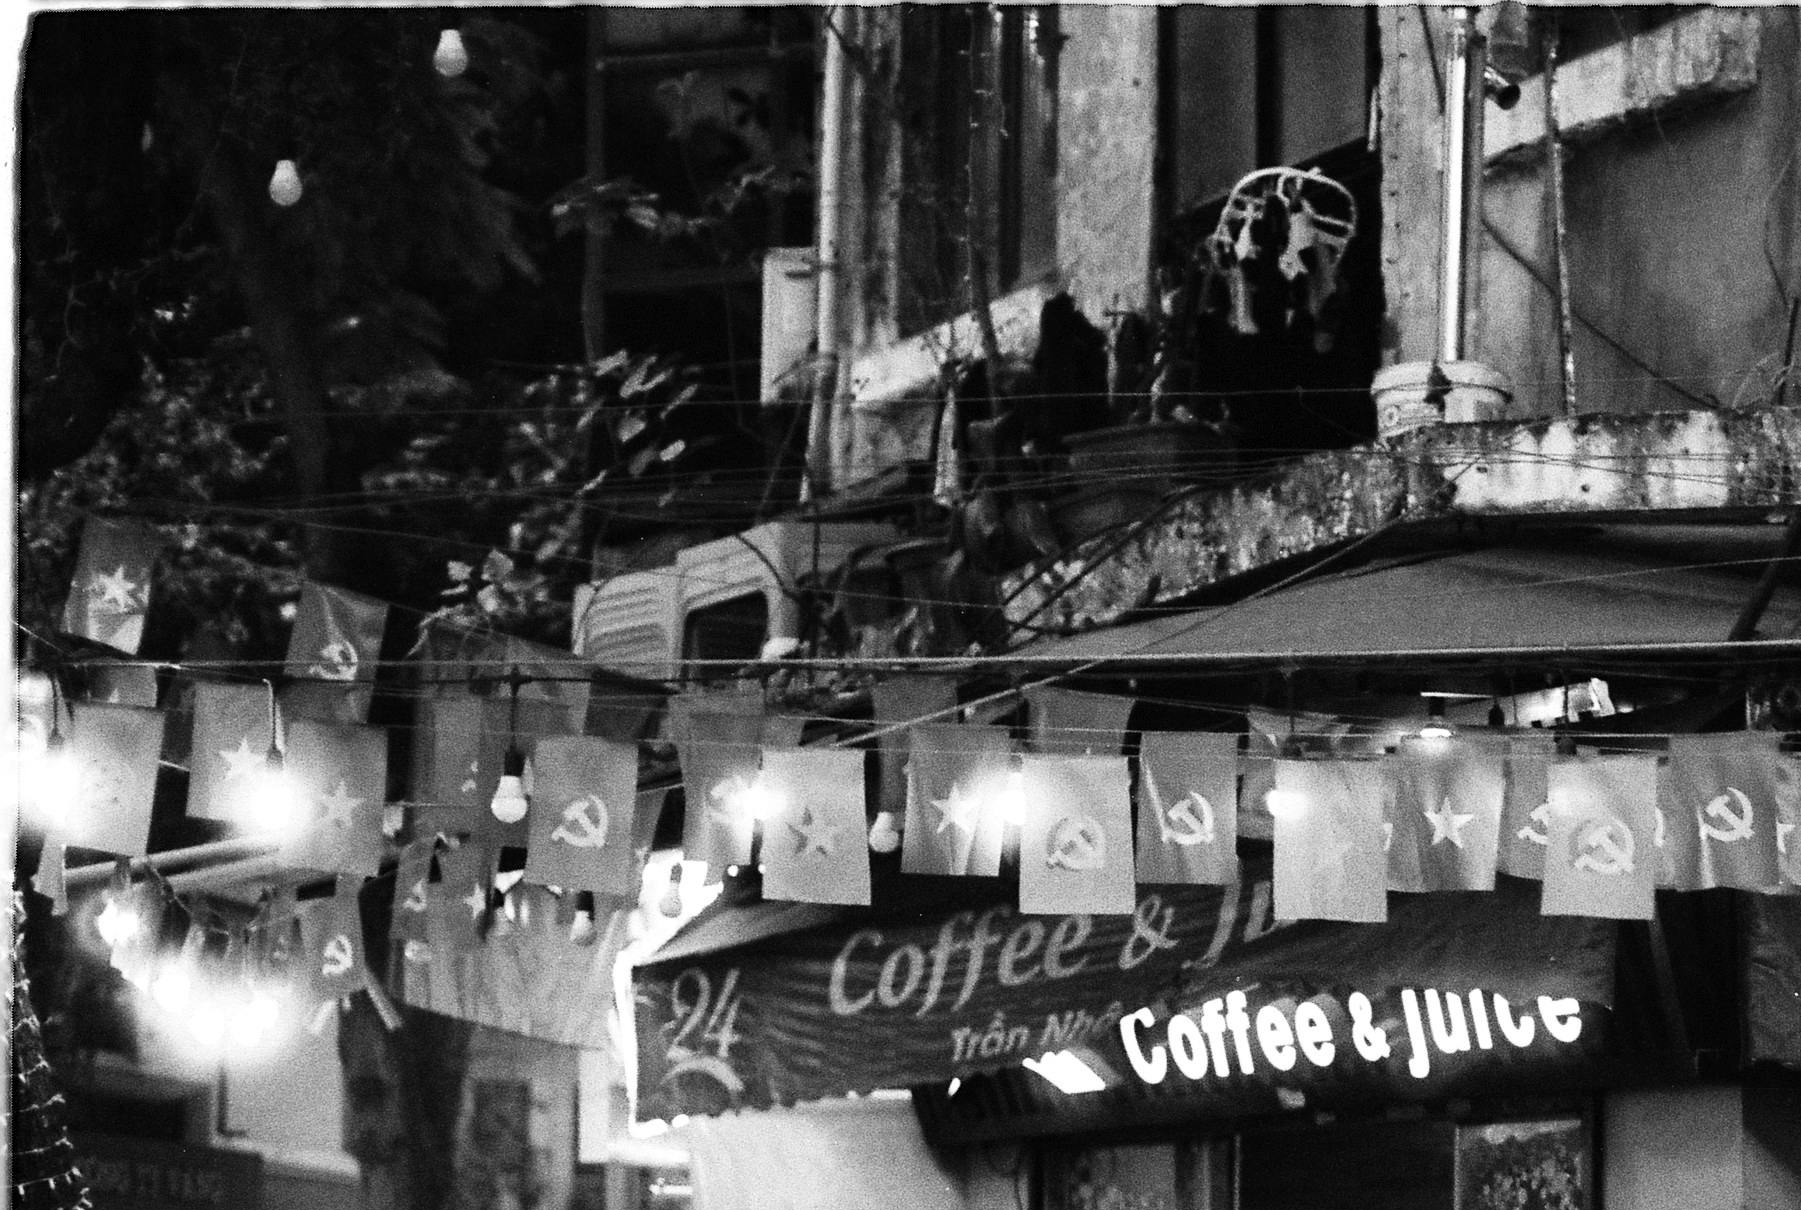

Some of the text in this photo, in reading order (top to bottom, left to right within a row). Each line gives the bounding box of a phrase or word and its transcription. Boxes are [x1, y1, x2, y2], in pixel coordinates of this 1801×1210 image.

[667, 967, 741, 1059] 24
[829, 905, 1091, 1018] Coffee
[1119, 894, 1179, 970] &
[1119, 990, 1336, 1084] Coffee
[1348, 992, 1391, 1062] &
